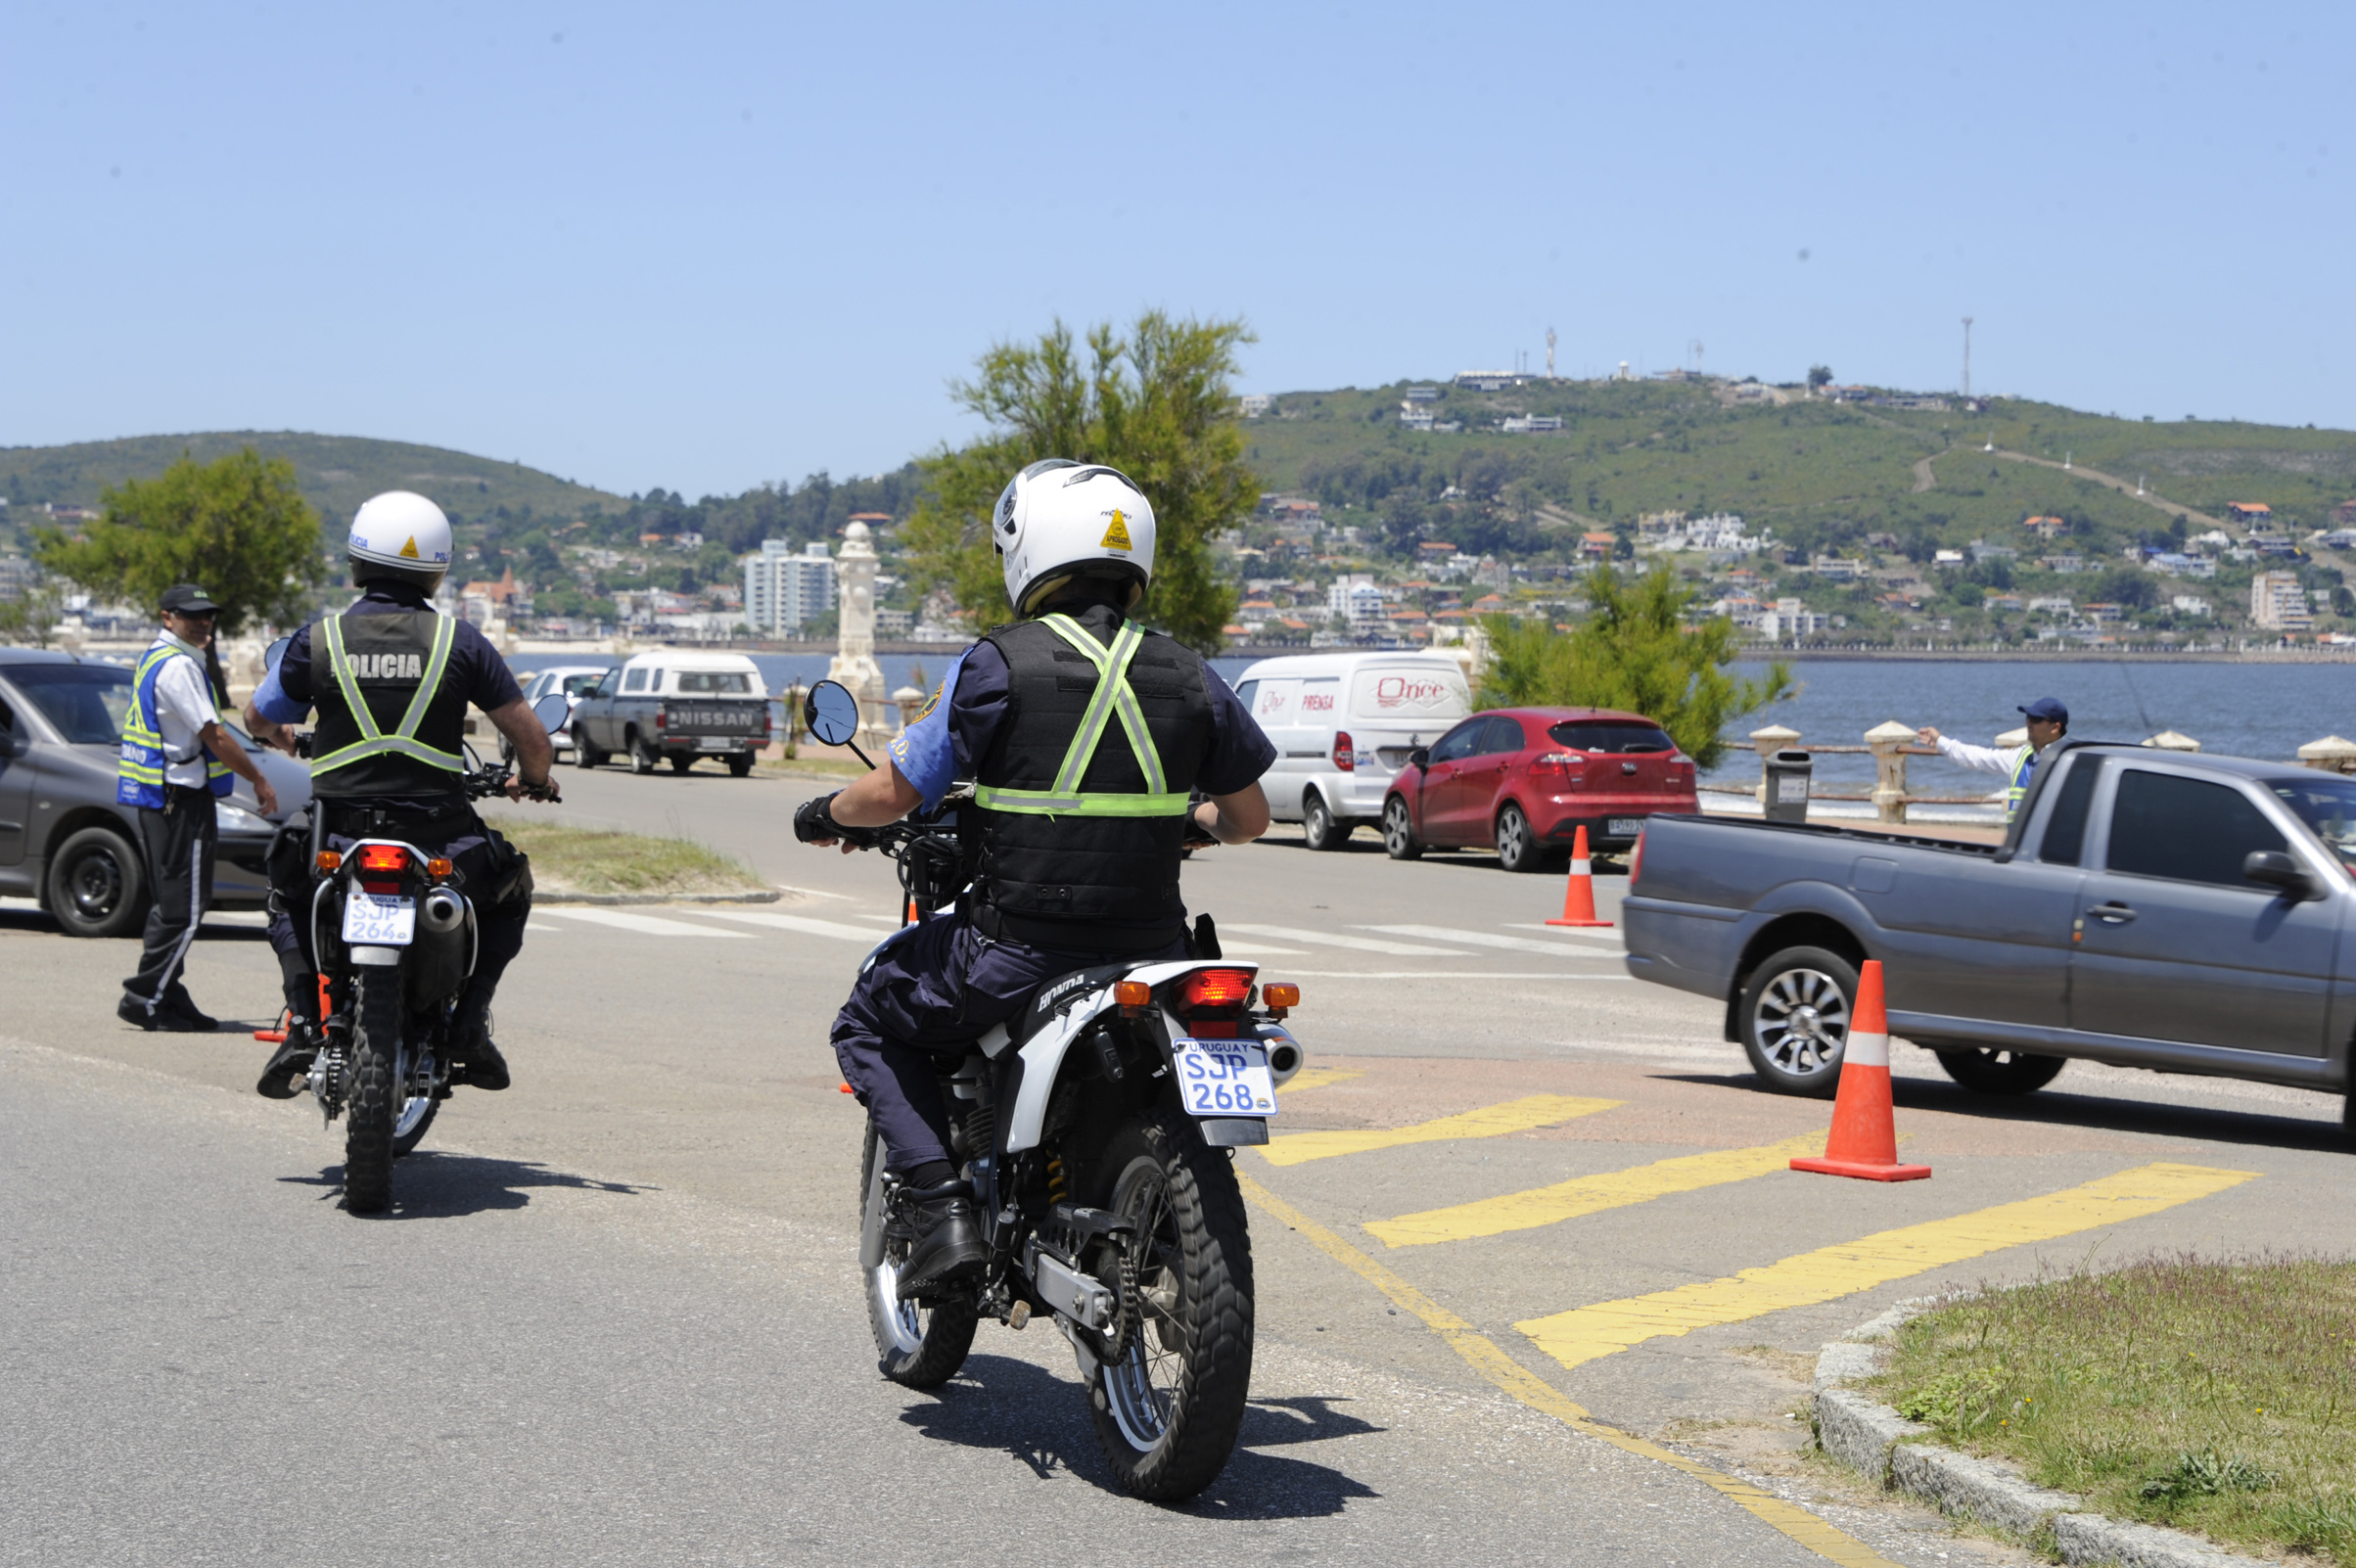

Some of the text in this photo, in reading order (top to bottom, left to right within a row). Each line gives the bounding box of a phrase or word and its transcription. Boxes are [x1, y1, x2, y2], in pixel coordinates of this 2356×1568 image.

[331, 654, 422, 678] OLICIA
[1378, 677, 1444, 699] Once
[1302, 695, 1334, 711] PRENSA
[678, 712, 753, 726] NISSAN
[352, 902, 399, 920] SJP
[351, 921, 394, 940] 264
[1189, 1042, 1248, 1052] URUGUAY
[1185, 1053, 1247, 1081] SJP
[1192, 1083, 1254, 1110] 268
